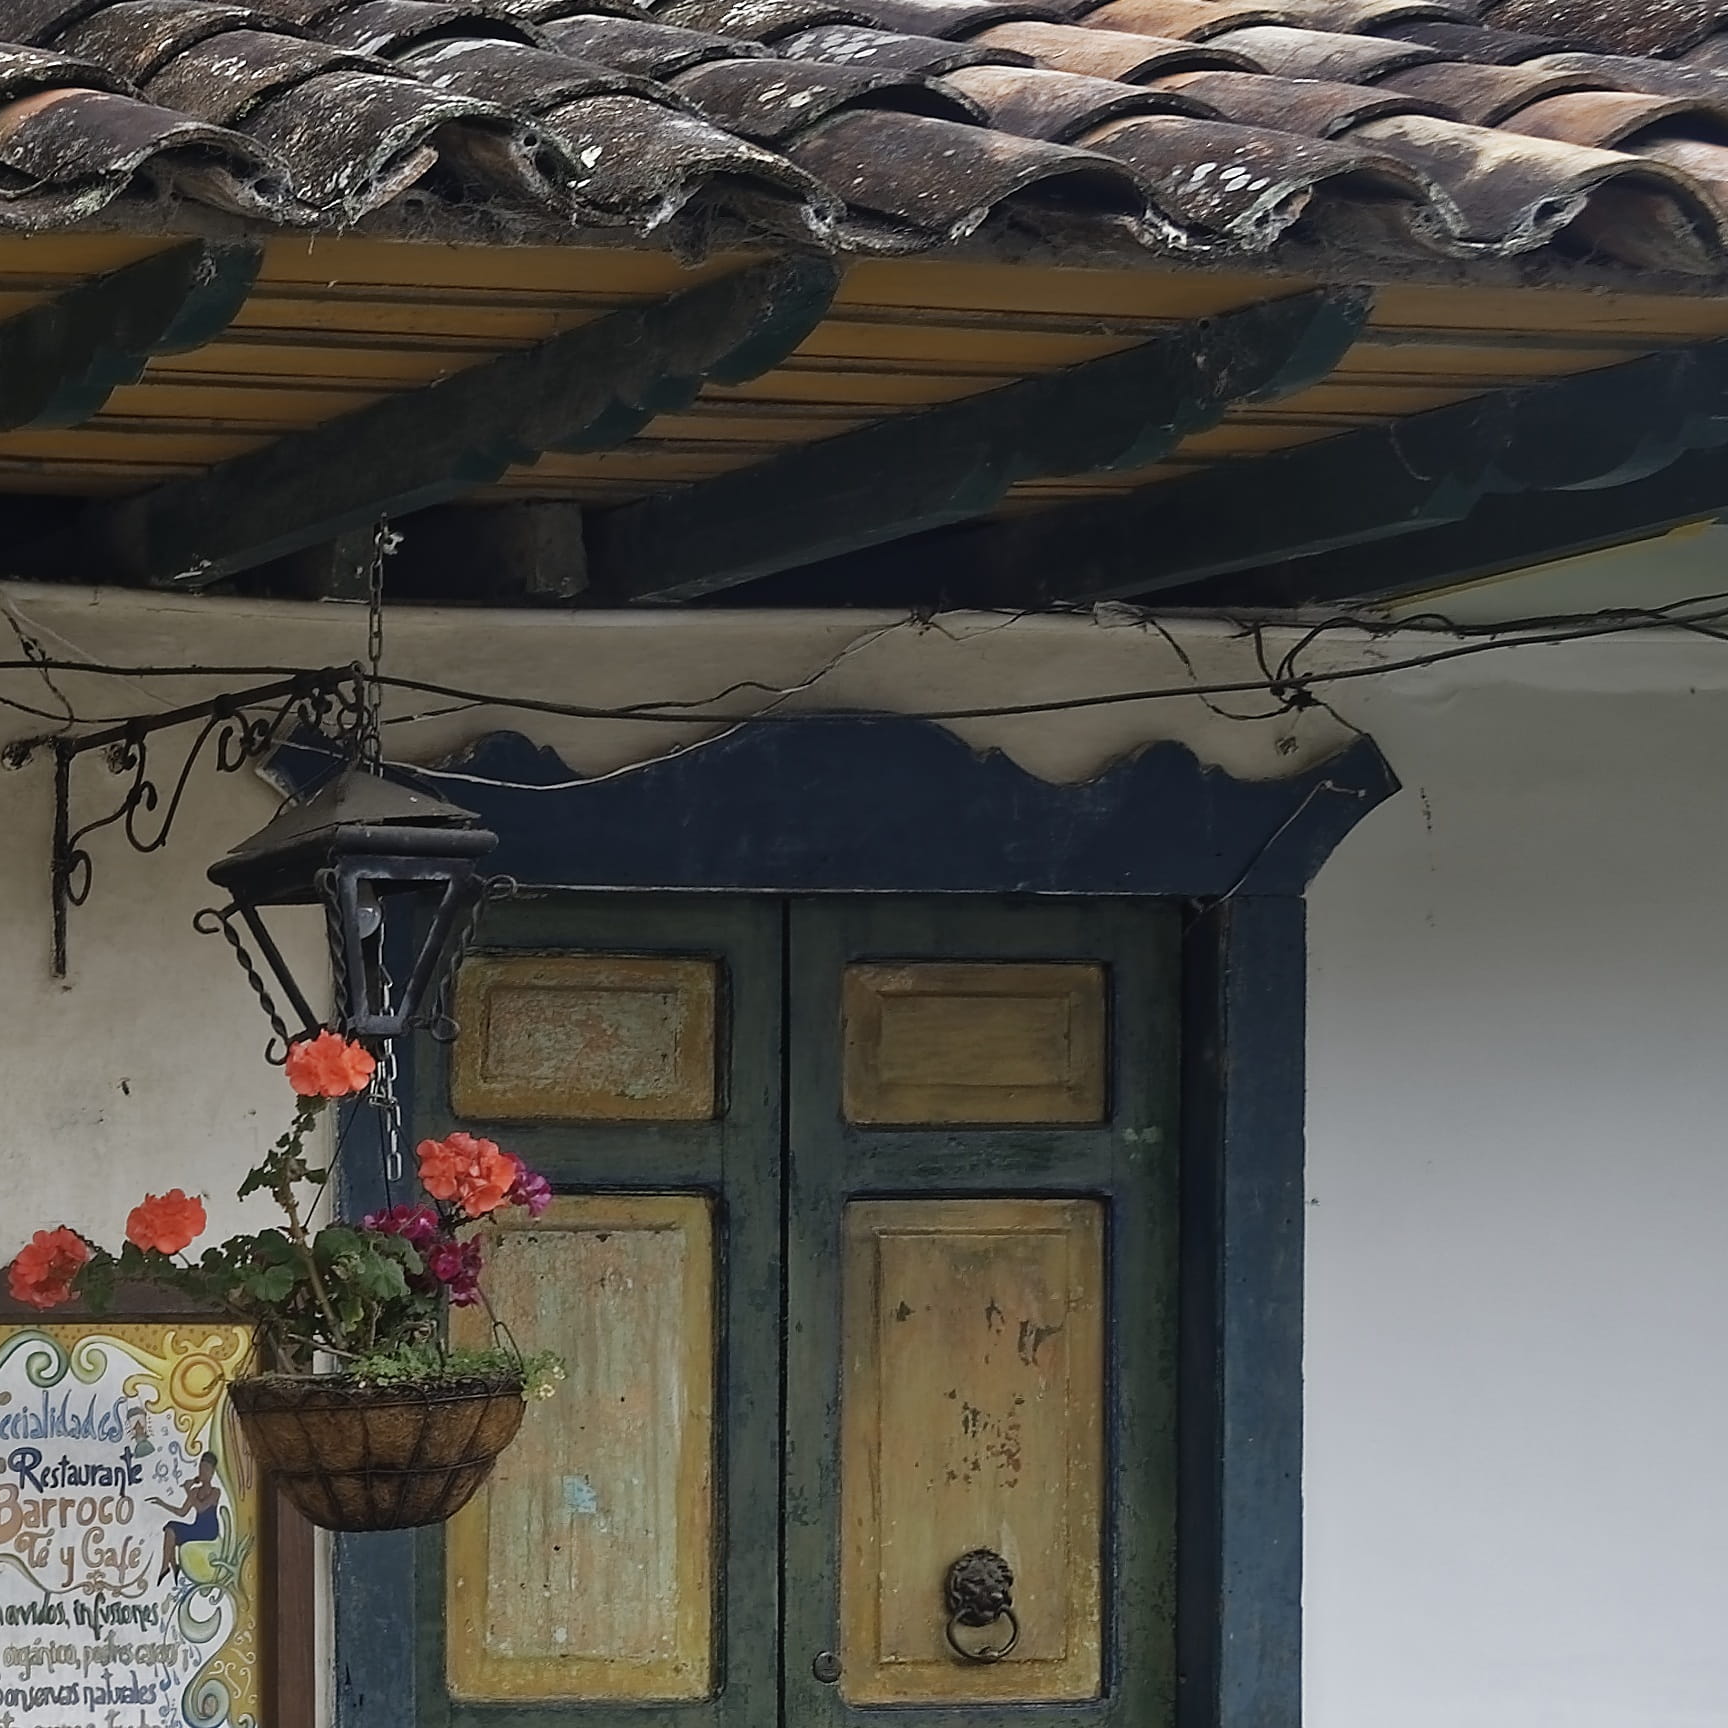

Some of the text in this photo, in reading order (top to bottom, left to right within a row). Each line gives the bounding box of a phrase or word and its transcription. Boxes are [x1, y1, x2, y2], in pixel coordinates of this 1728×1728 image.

[7, 1446, 143, 1497] Restaurante
[14, 1526, 146, 1588] Té y Café
[84, 1667, 157, 1712] naturales
